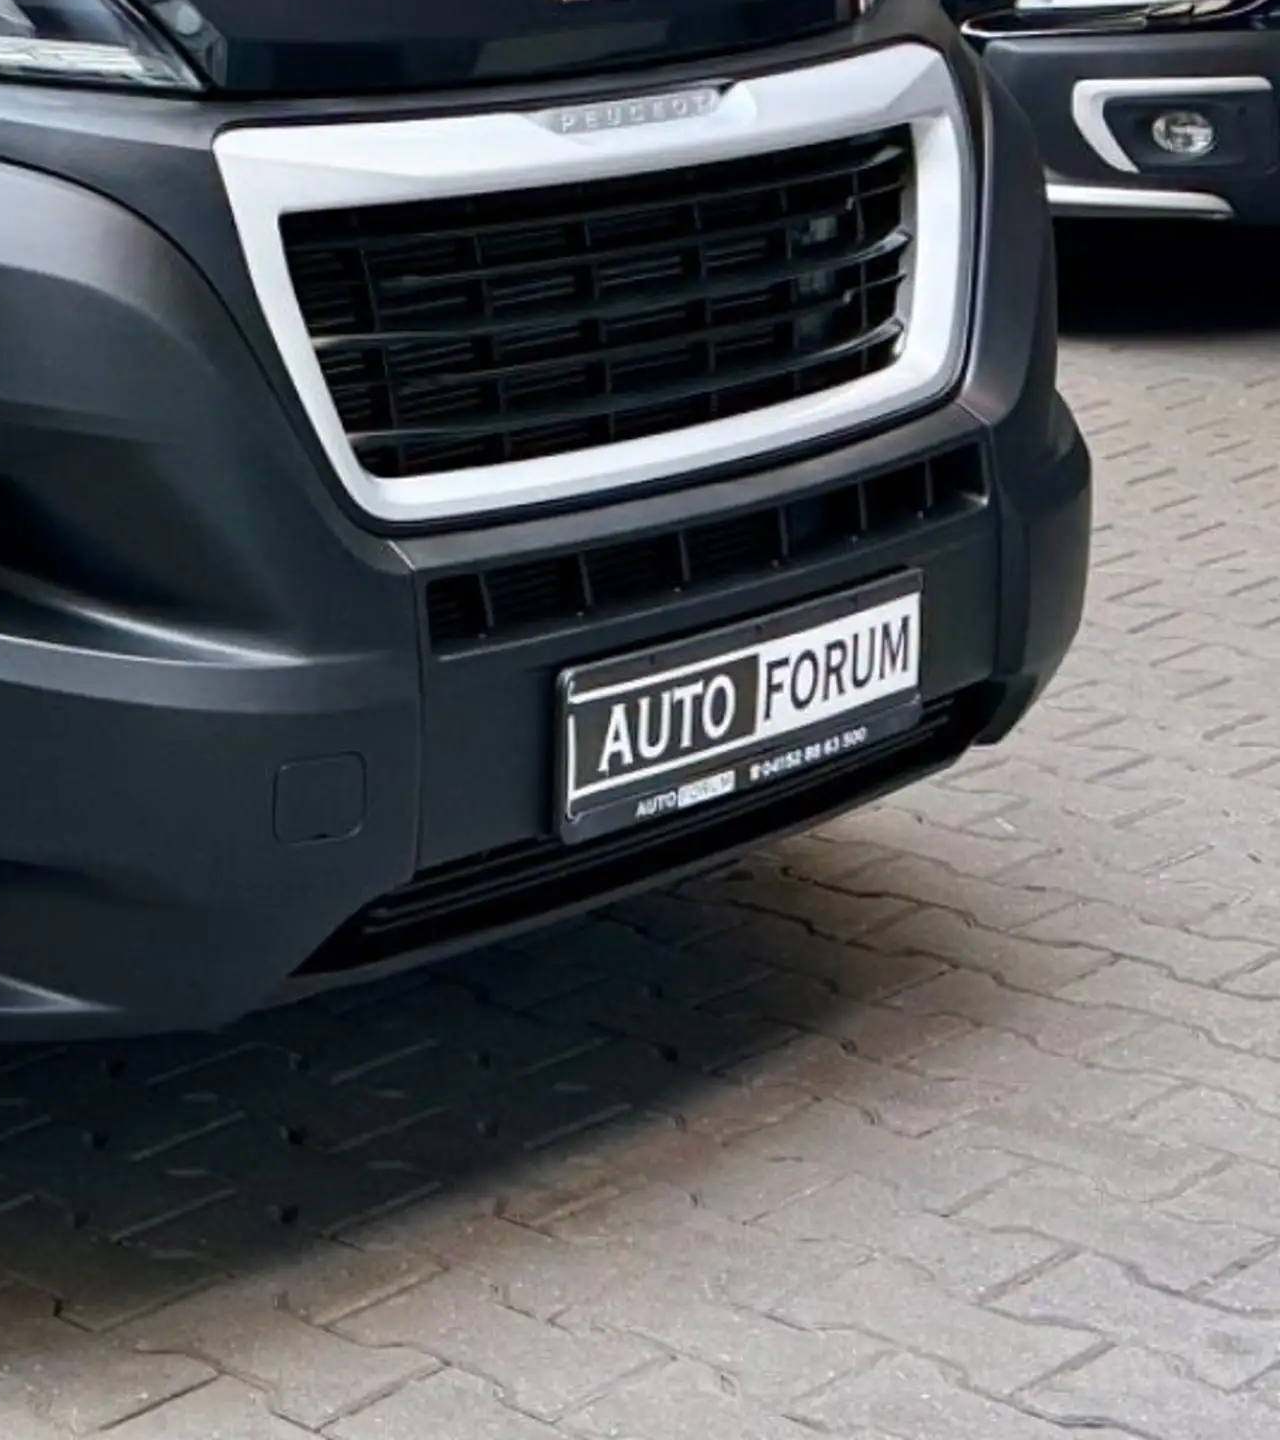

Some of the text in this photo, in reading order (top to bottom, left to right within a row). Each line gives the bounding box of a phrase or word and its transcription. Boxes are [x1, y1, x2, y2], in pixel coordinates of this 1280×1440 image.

[560, 94, 710, 133] PEUGEOT
[596, 614, 912, 774] AUTO FORUM
